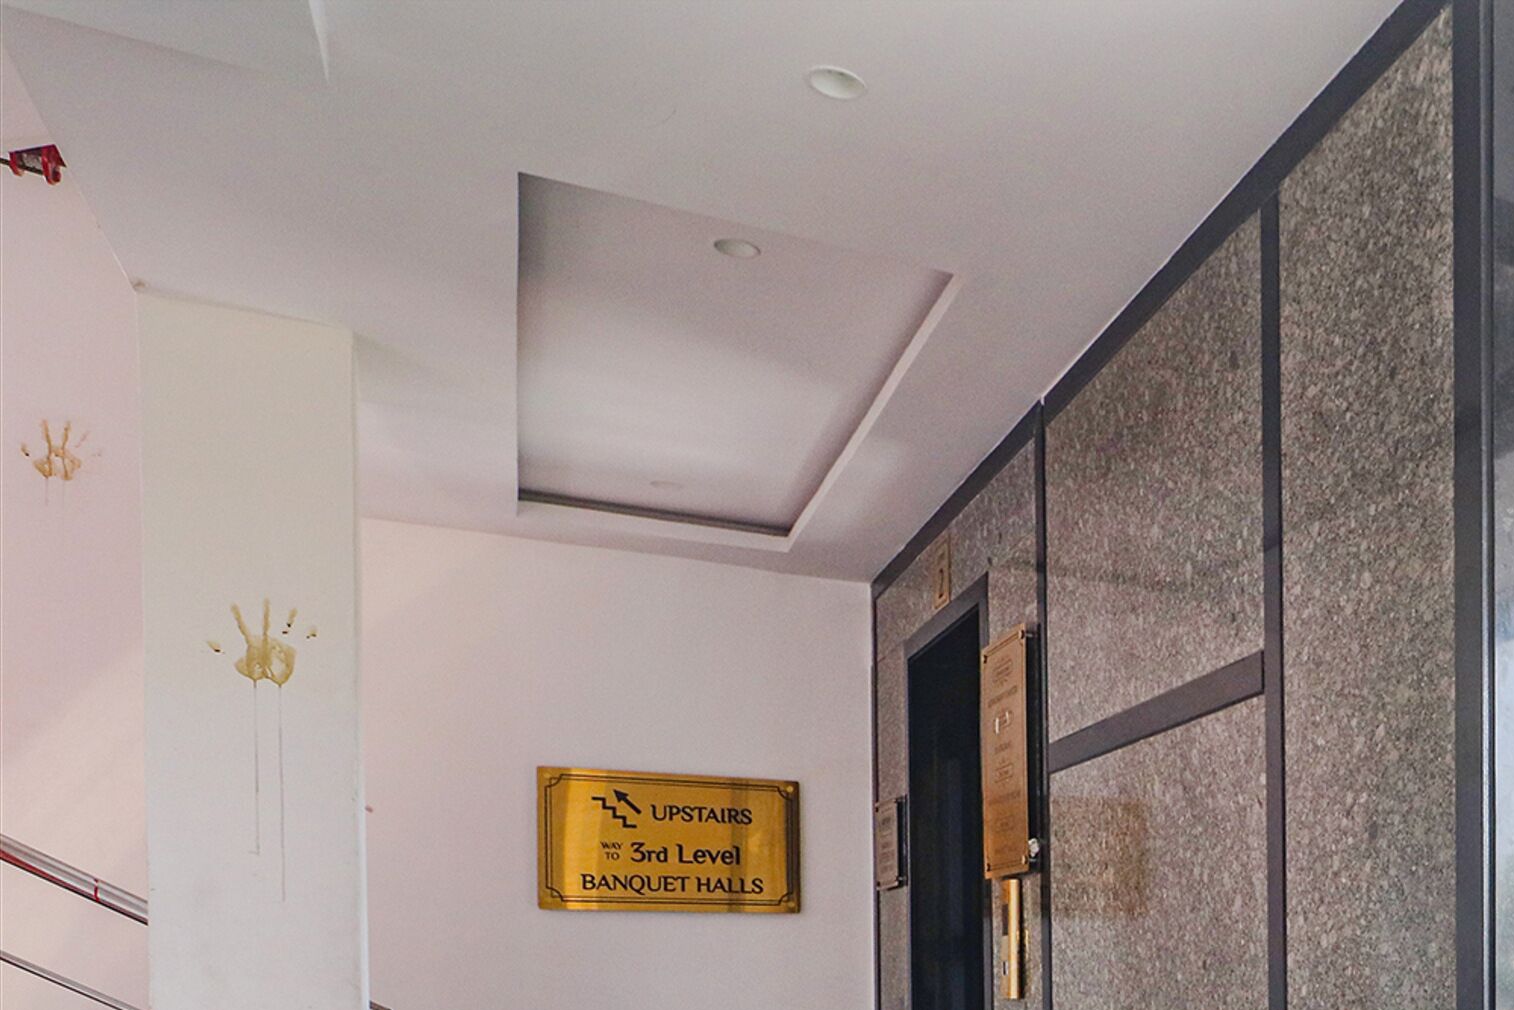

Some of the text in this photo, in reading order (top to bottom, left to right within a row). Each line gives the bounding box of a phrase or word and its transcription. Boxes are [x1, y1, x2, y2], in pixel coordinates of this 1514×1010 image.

[651, 804, 753, 825] UPSTAIRS
[600, 840, 623, 850] WAY
[630, 841, 742, 866] 3rd Level
[604, 851, 620, 861] TO
[580, 873, 764, 896] BANQUET HALLS
